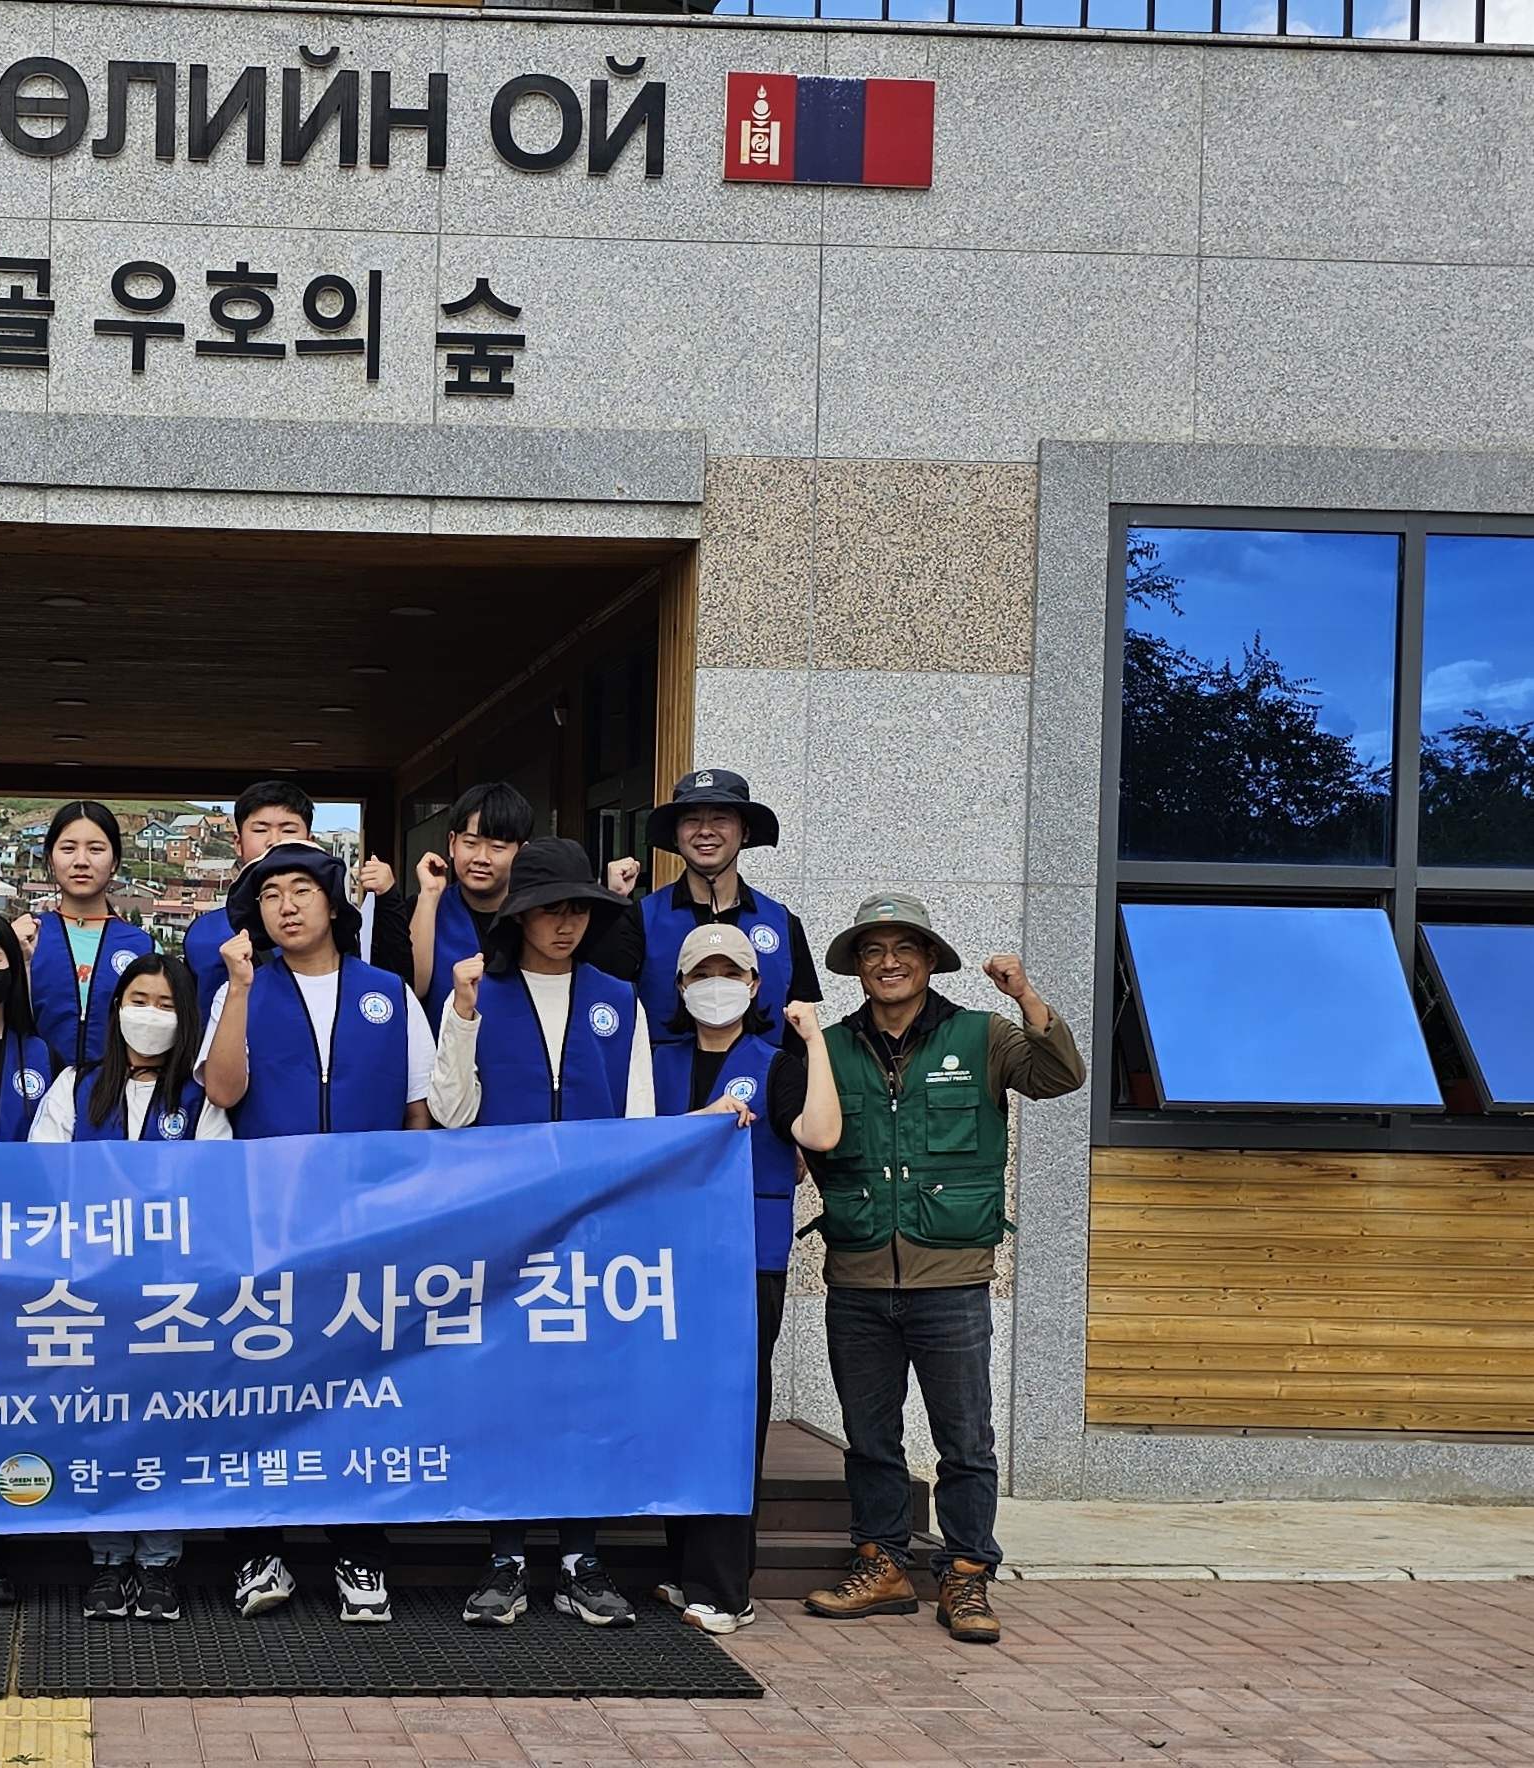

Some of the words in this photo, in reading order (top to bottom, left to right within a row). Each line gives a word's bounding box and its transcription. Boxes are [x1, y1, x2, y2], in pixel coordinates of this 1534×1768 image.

[489, 55, 666, 179] ОЙ
[93, 260, 382, 384] 우호의
[434, 277, 526, 399] 숲
[16, 1278, 105, 1367] 숲
[128, 1271, 294, 1361] 조성
[321, 1260, 486, 1351] 사업
[513, 1247, 677, 1343] 참여
[142, 1376, 403, 1421] АЖИЛЛАГАА
[68, 1457, 166, 1493] 한-몽
[181, 1449, 327, 1487] 그린벨트
[342, 1445, 451, 1484] 사업단
